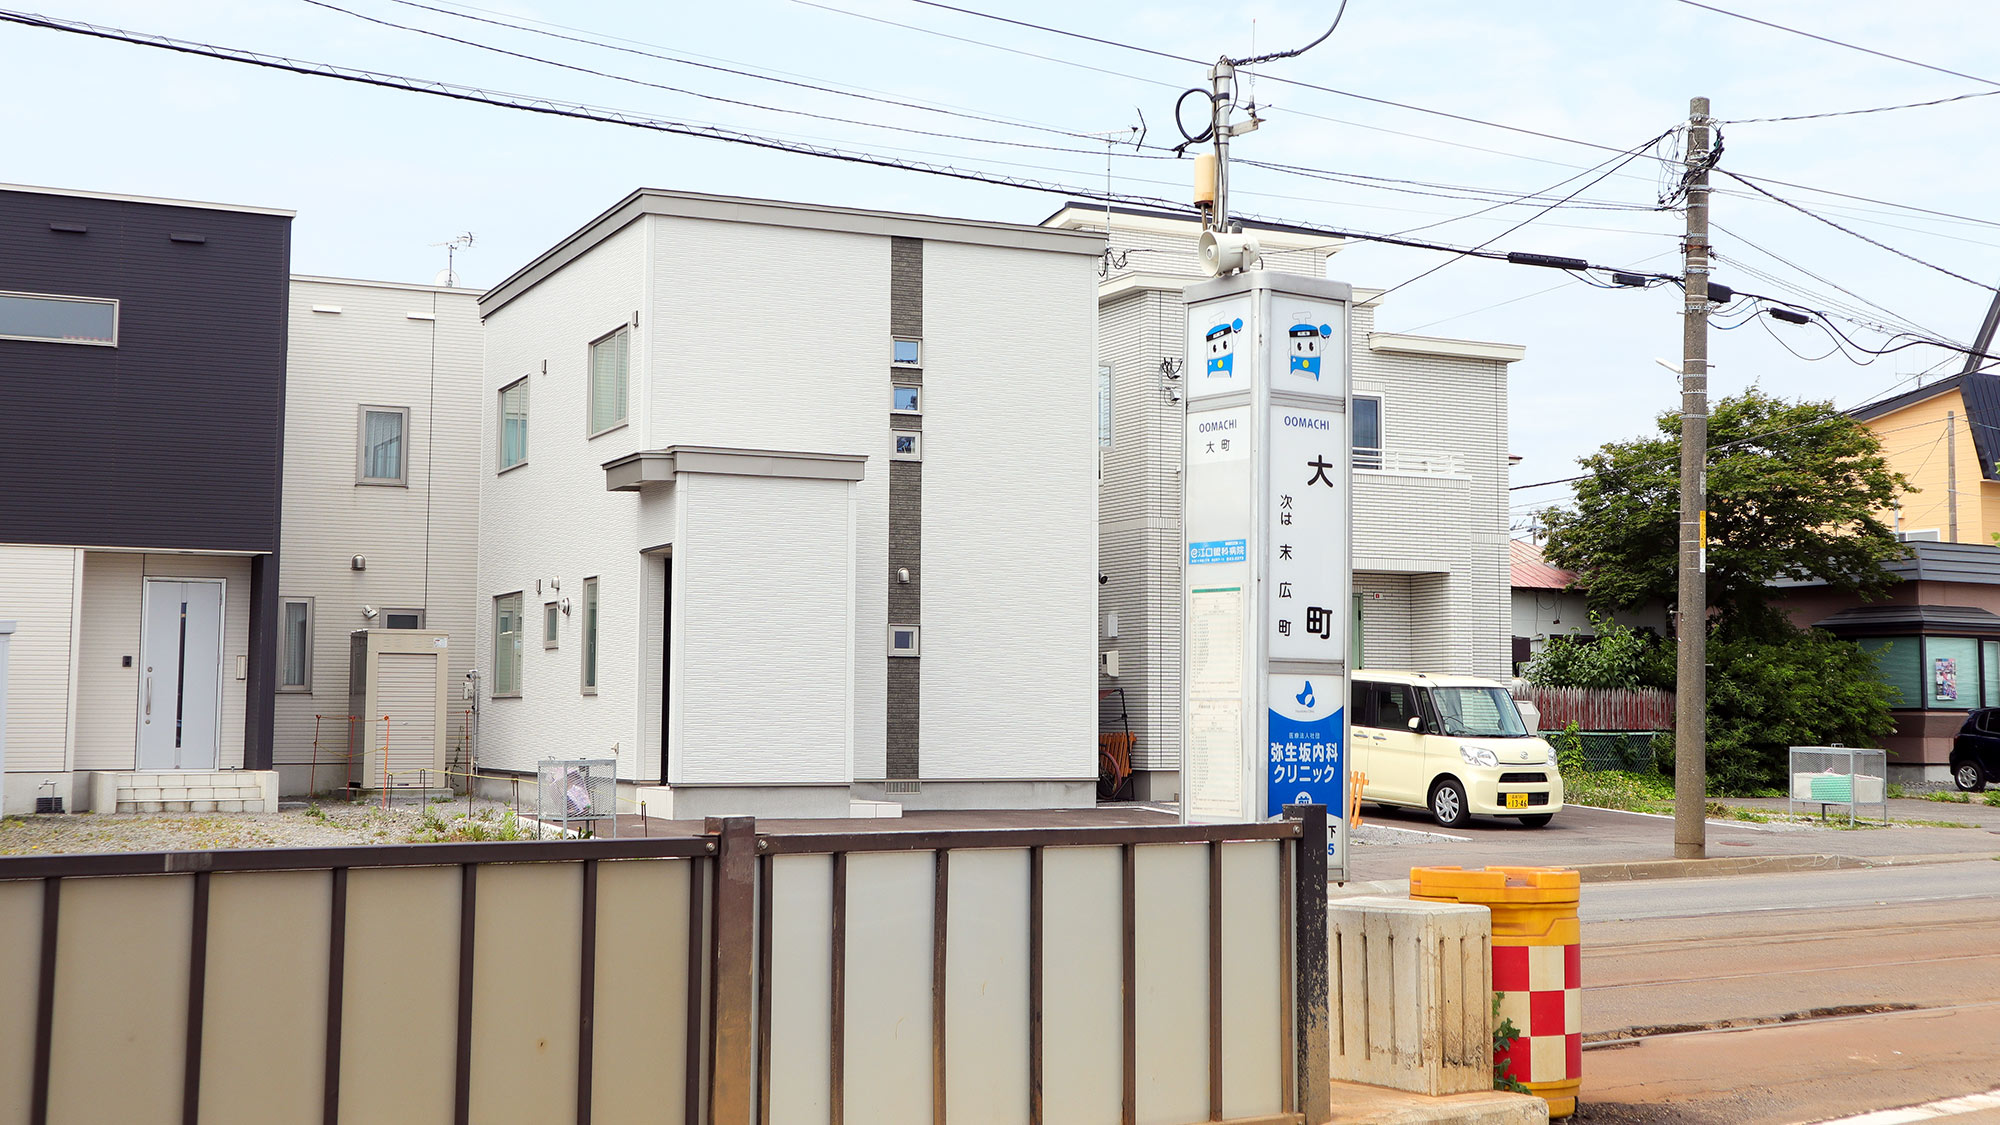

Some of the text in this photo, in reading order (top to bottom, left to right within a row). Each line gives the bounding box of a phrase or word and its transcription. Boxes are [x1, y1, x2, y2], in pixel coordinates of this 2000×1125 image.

[1199, 418, 1237, 434] OOMACHI
[1284, 415, 1330, 431] OOMACHI
[1205, 438, 1231, 454] 大町
[1270, 742, 1338, 763] 弥生坂内科
[1273, 764, 1335, 784] クリニック
